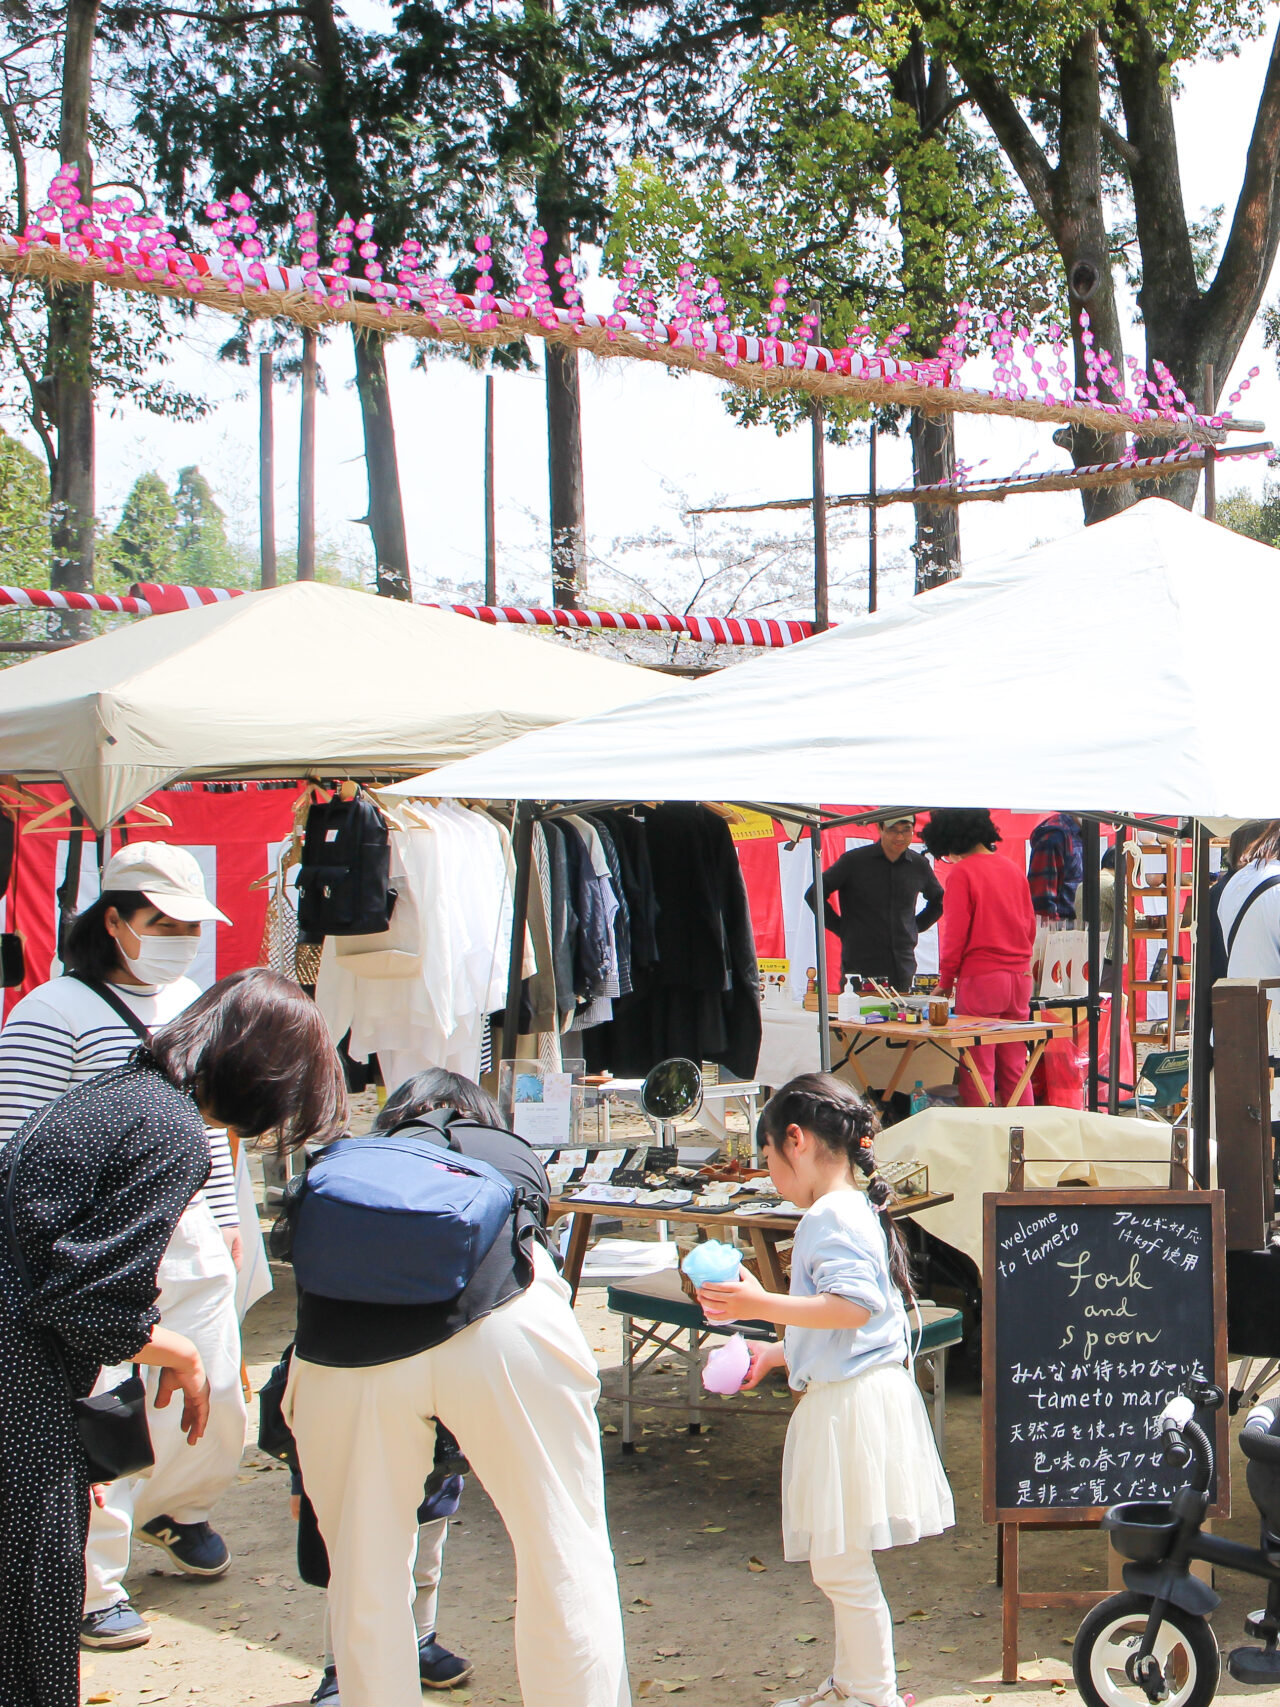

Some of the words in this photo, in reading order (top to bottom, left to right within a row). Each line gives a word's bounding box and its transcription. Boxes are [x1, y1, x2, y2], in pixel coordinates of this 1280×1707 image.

[1000, 1211, 1058, 1250] welcome
[1112, 1211, 1202, 1245] アレルギー対応
[998, 1260, 1016, 1278] to
[1022, 1222, 1080, 1265] tameto
[1084, 1296, 1138, 1318] and
[1010, 1358, 1204, 1384] みんなが待ちわびていた
[1028, 1387, 1114, 1410] tameto
[155, 1528, 182, 1546] N
